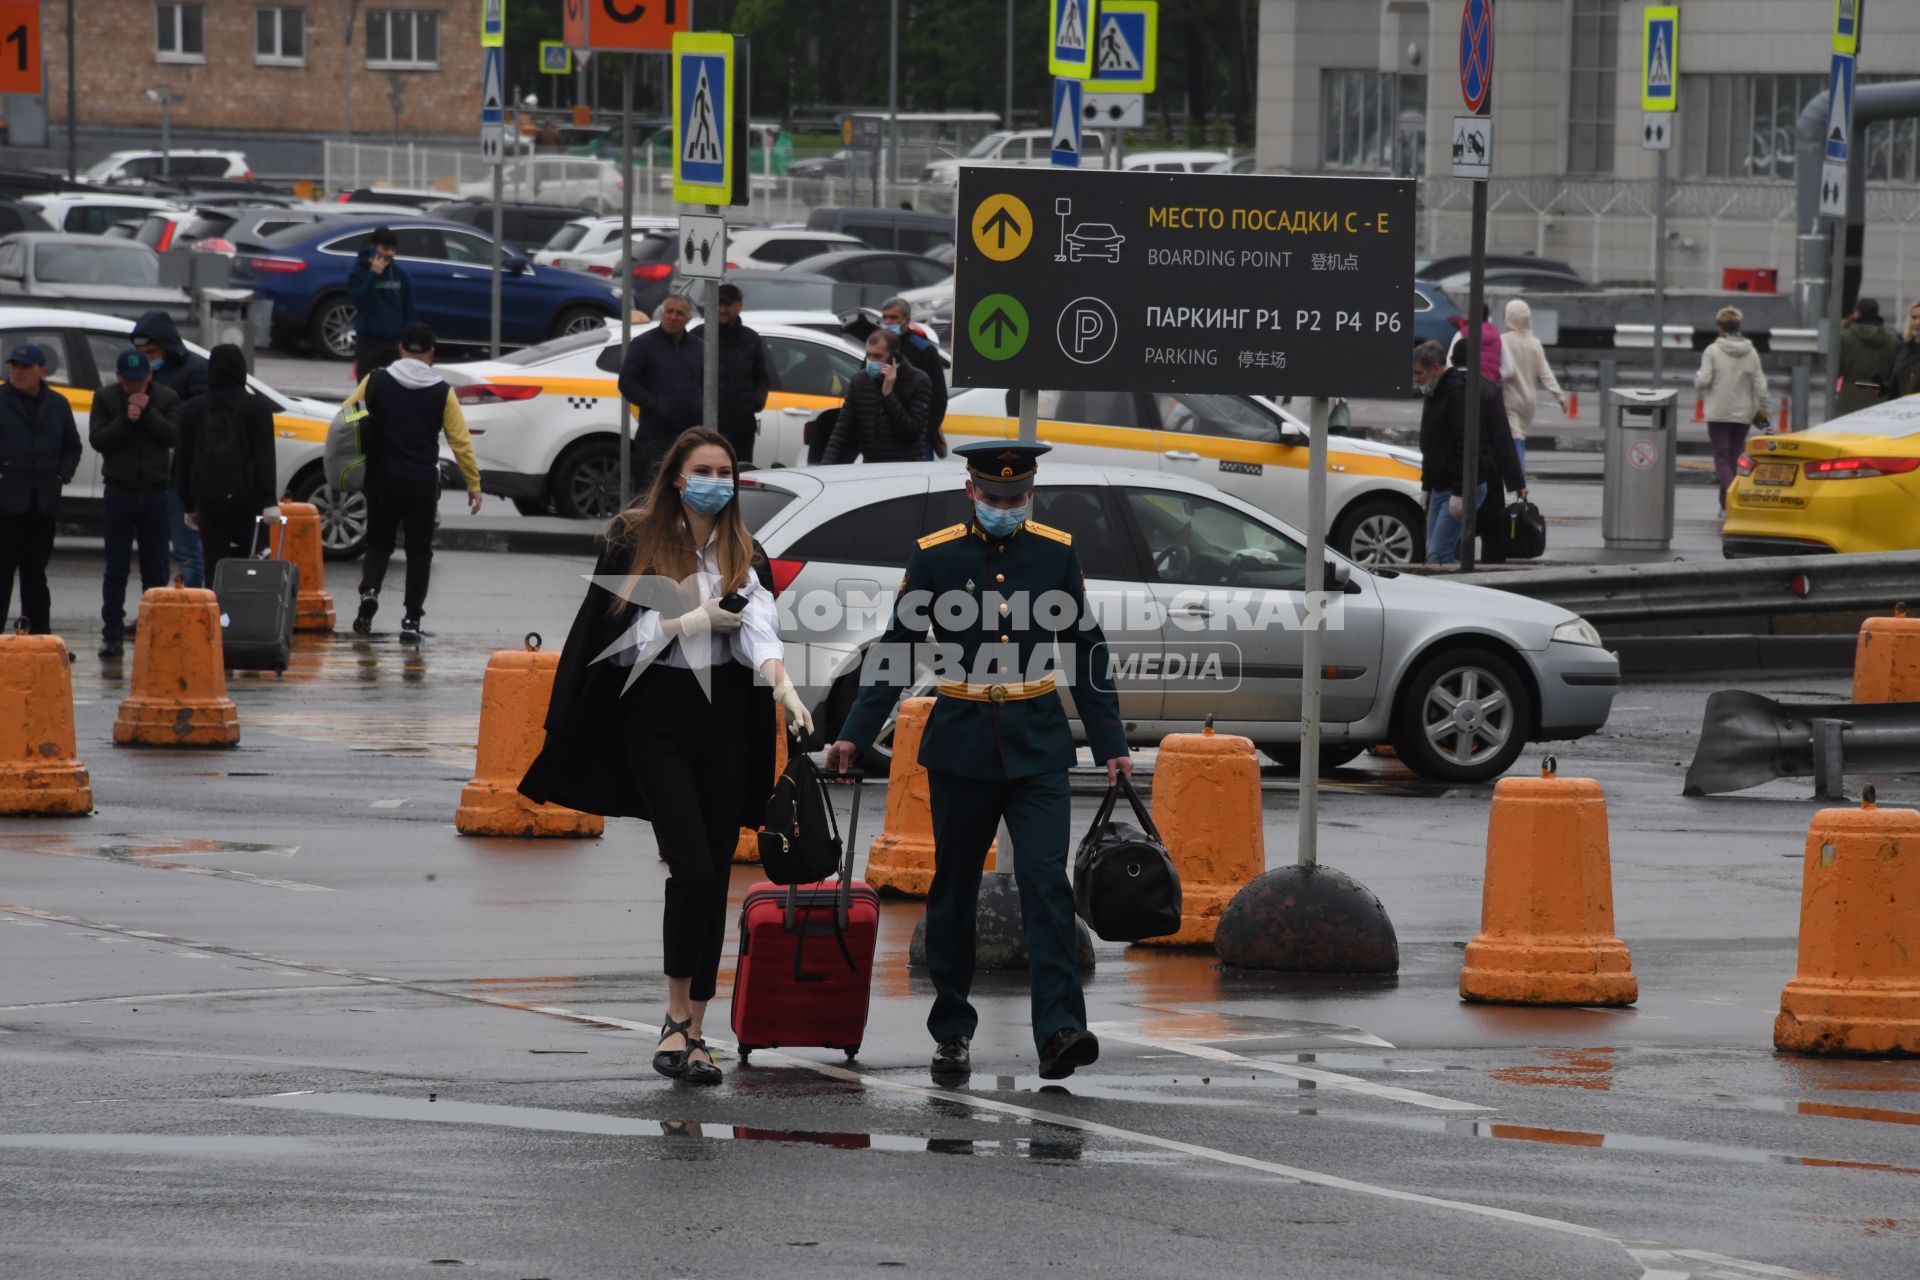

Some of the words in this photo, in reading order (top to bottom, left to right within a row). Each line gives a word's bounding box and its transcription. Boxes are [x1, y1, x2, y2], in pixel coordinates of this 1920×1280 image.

[1149, 207, 1225, 229] МЕСТО
[1231, 209, 1338, 234] ПОСАДКИ
[1148, 249, 1235, 267] BOARDING
[1241, 251, 1293, 268] POINT
[1311, 253, 1359, 271] 登机点
[1146, 306, 1250, 329] ПАРКИНГ
[1256, 309, 1282, 330] P1
[1296, 310, 1321, 331] P2
[1335, 311, 1362, 332] P4
[1375, 312, 1401, 333] P6
[1144, 347, 1218, 366] PARKING
[1237, 350, 1287, 369] 停车场
